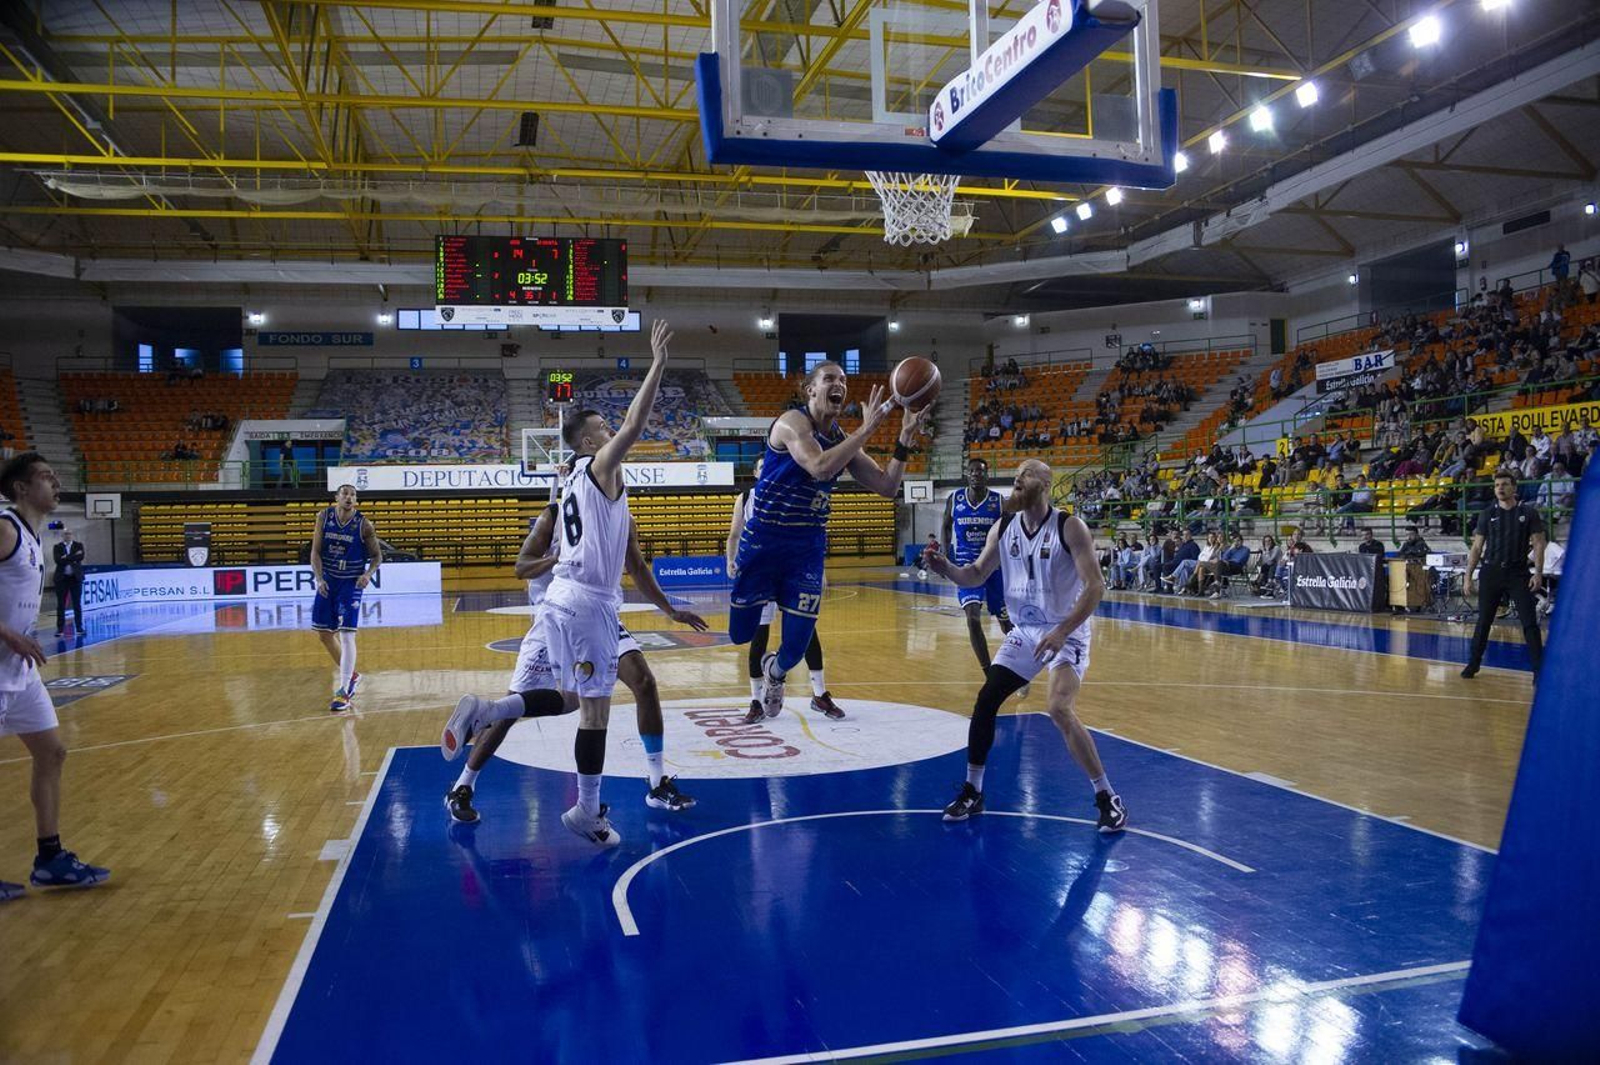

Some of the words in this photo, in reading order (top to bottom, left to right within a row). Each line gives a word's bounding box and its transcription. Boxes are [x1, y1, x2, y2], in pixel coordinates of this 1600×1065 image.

[949, 25, 1037, 115] BricoCentro
[517, 272, 548, 285] 03:52
[269, 333, 323, 344] FONDO
[331, 333, 363, 344] SUR
[412, 358, 420, 369] 3
[619, 358, 627, 368] 4
[1354, 355, 1384, 371] BAR
[556, 384, 571, 398] 17
[563, 492, 582, 547] 8
[659, 568, 687, 576] Estrella
[687, 567, 713, 576] Galicia
[1028, 554, 1035, 580] 1
[253, 570, 381, 592] PERN
[1296, 575, 1327, 588] Estrella
[1327, 575, 1357, 589] Galicia
[83, 578, 119, 605] ERSAN
[134, 586, 184, 597] PERSAN
[798, 593, 820, 613] 27
